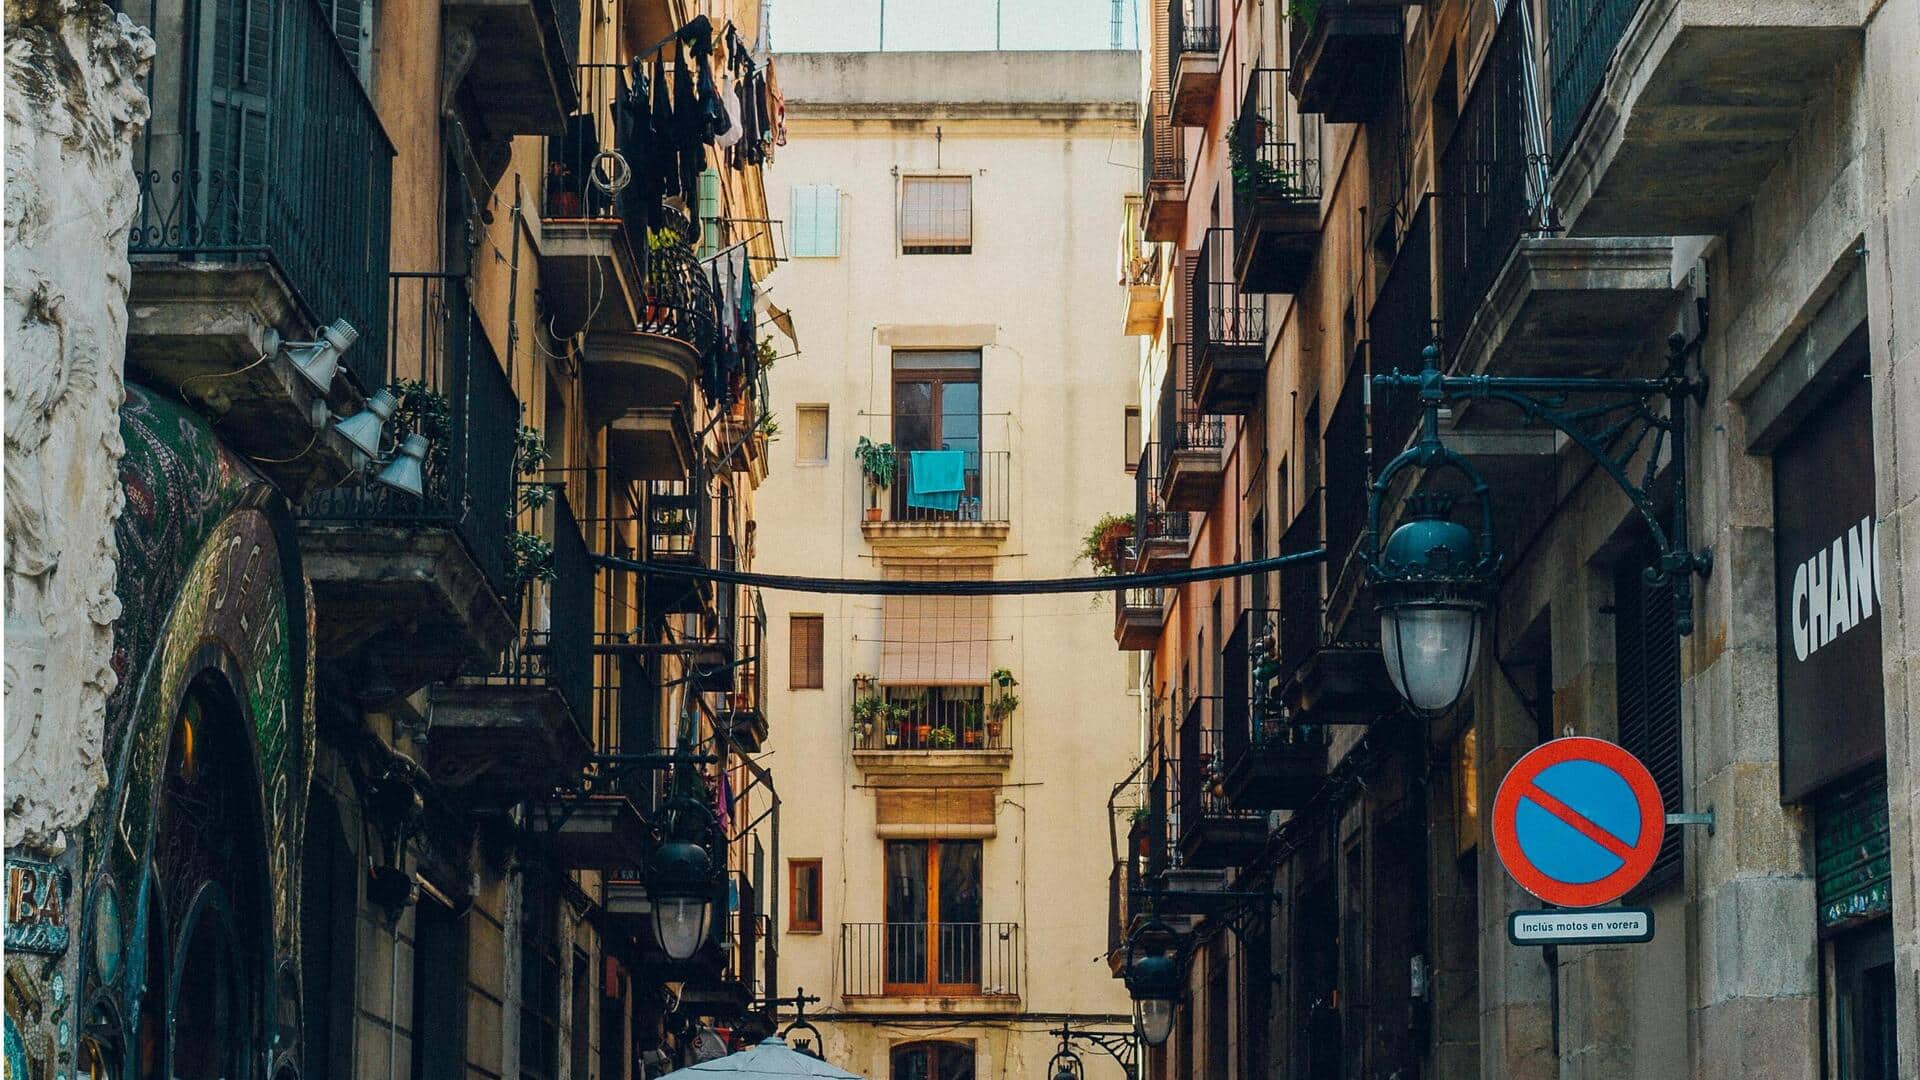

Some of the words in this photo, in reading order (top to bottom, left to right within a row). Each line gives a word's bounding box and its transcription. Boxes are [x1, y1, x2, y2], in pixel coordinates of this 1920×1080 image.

[1522, 922, 1554, 932] Inclús
[1556, 922, 1588, 931] motos
[1591, 922, 1604, 930] en
[1607, 920, 1639, 929] vorera
